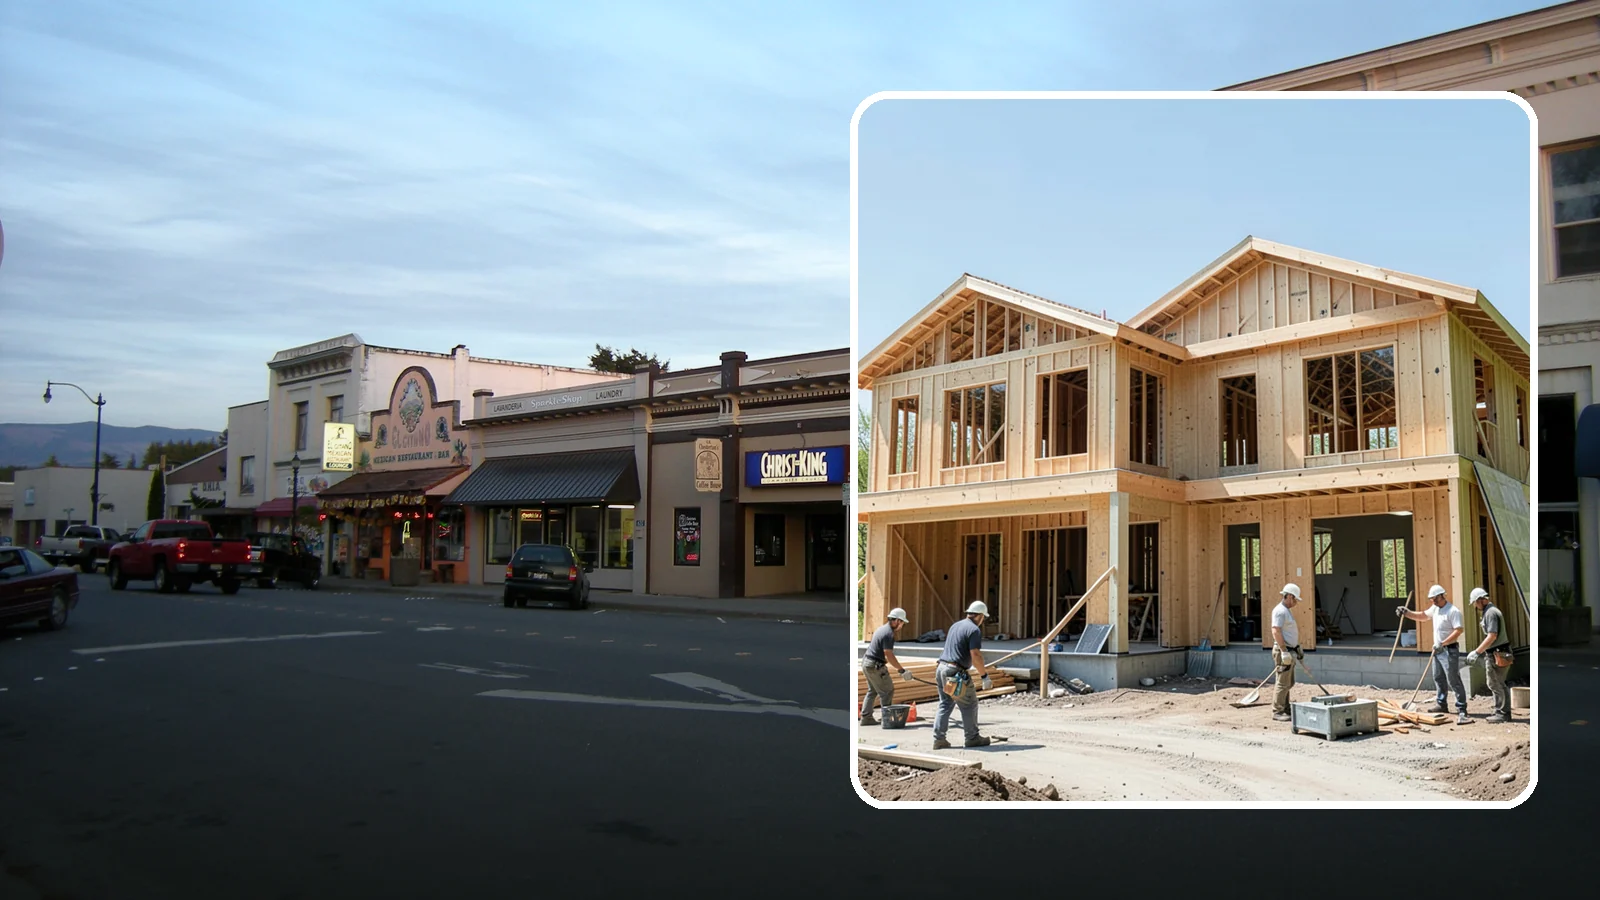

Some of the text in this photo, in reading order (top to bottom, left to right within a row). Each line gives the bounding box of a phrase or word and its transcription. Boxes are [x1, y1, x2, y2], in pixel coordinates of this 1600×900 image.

[494, 402, 523, 412] LAVANDERIA
[561, 394, 582, 404] Shop
[595, 389, 624, 400] LAUNDRY
[373, 450, 450, 464] MEXICAN RESTAURANT BAR
[761, 450, 827, 478] CHRIST KING
